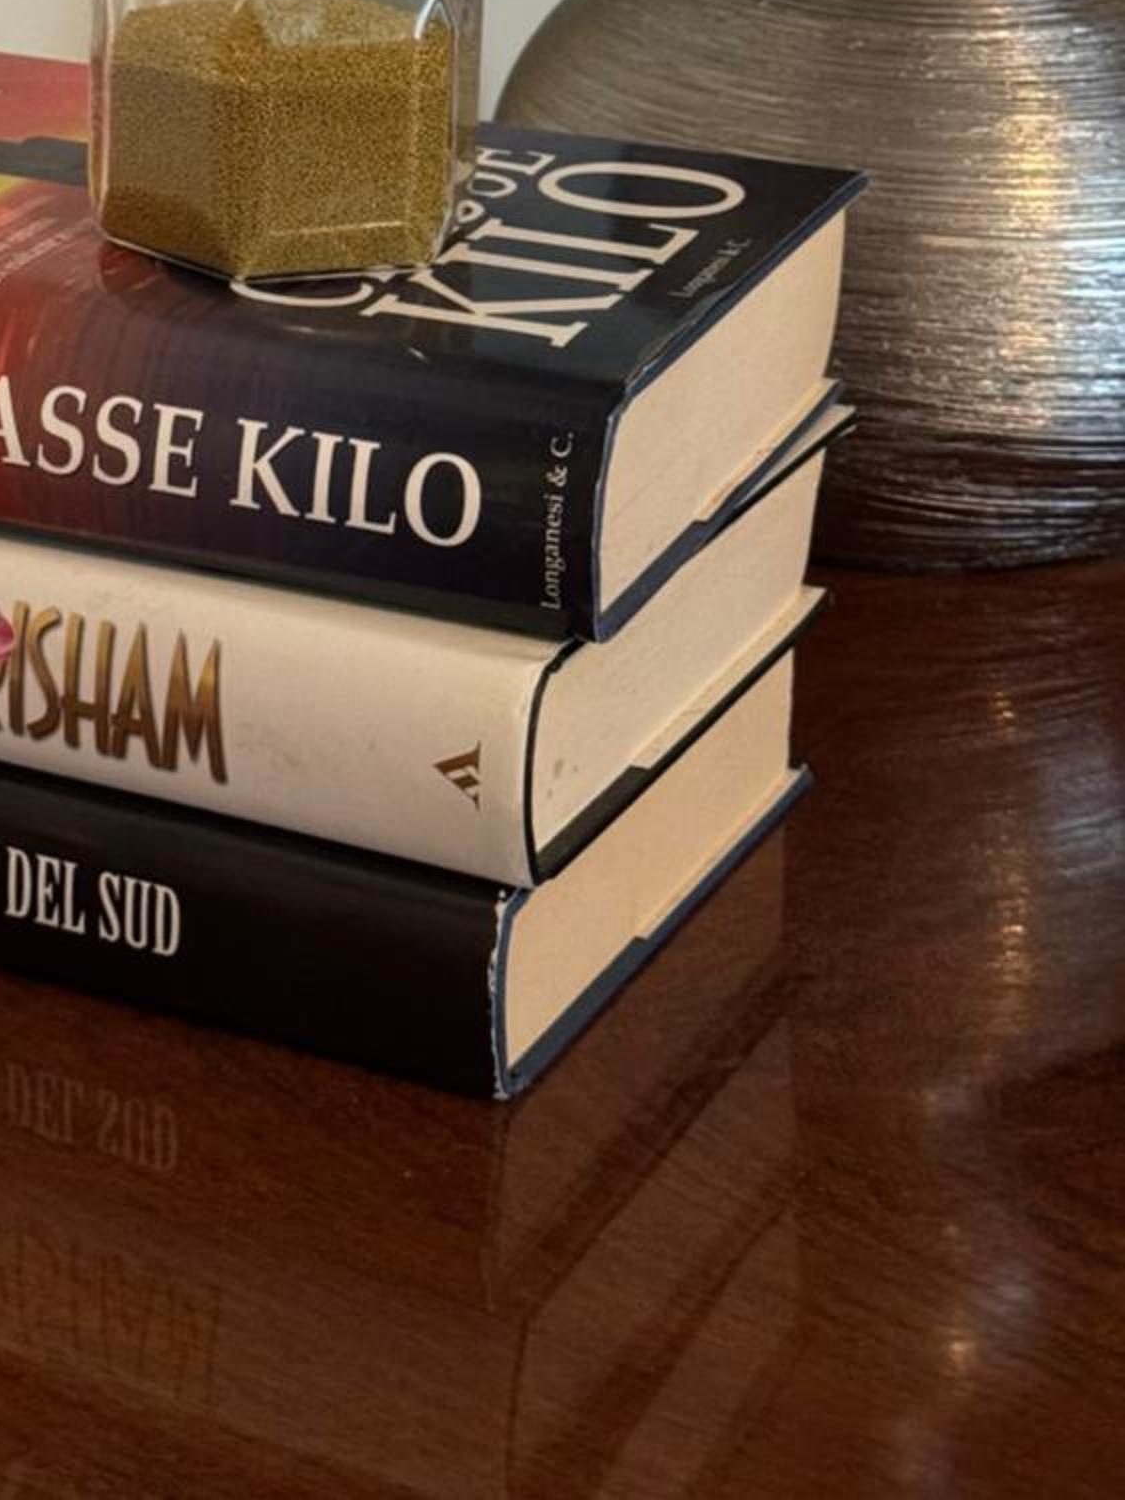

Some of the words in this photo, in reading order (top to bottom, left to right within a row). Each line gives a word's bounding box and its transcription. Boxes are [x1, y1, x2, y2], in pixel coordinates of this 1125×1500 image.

[360, 162, 745, 348] KILO
[230, 417, 482, 548] KILO
[546, 464, 568, 488] &
[550, 431, 574, 459] C.
[540, 493, 567, 610] Longanesi
[4, 846, 86, 935] DEL
[97, 871, 181, 957] SUD
